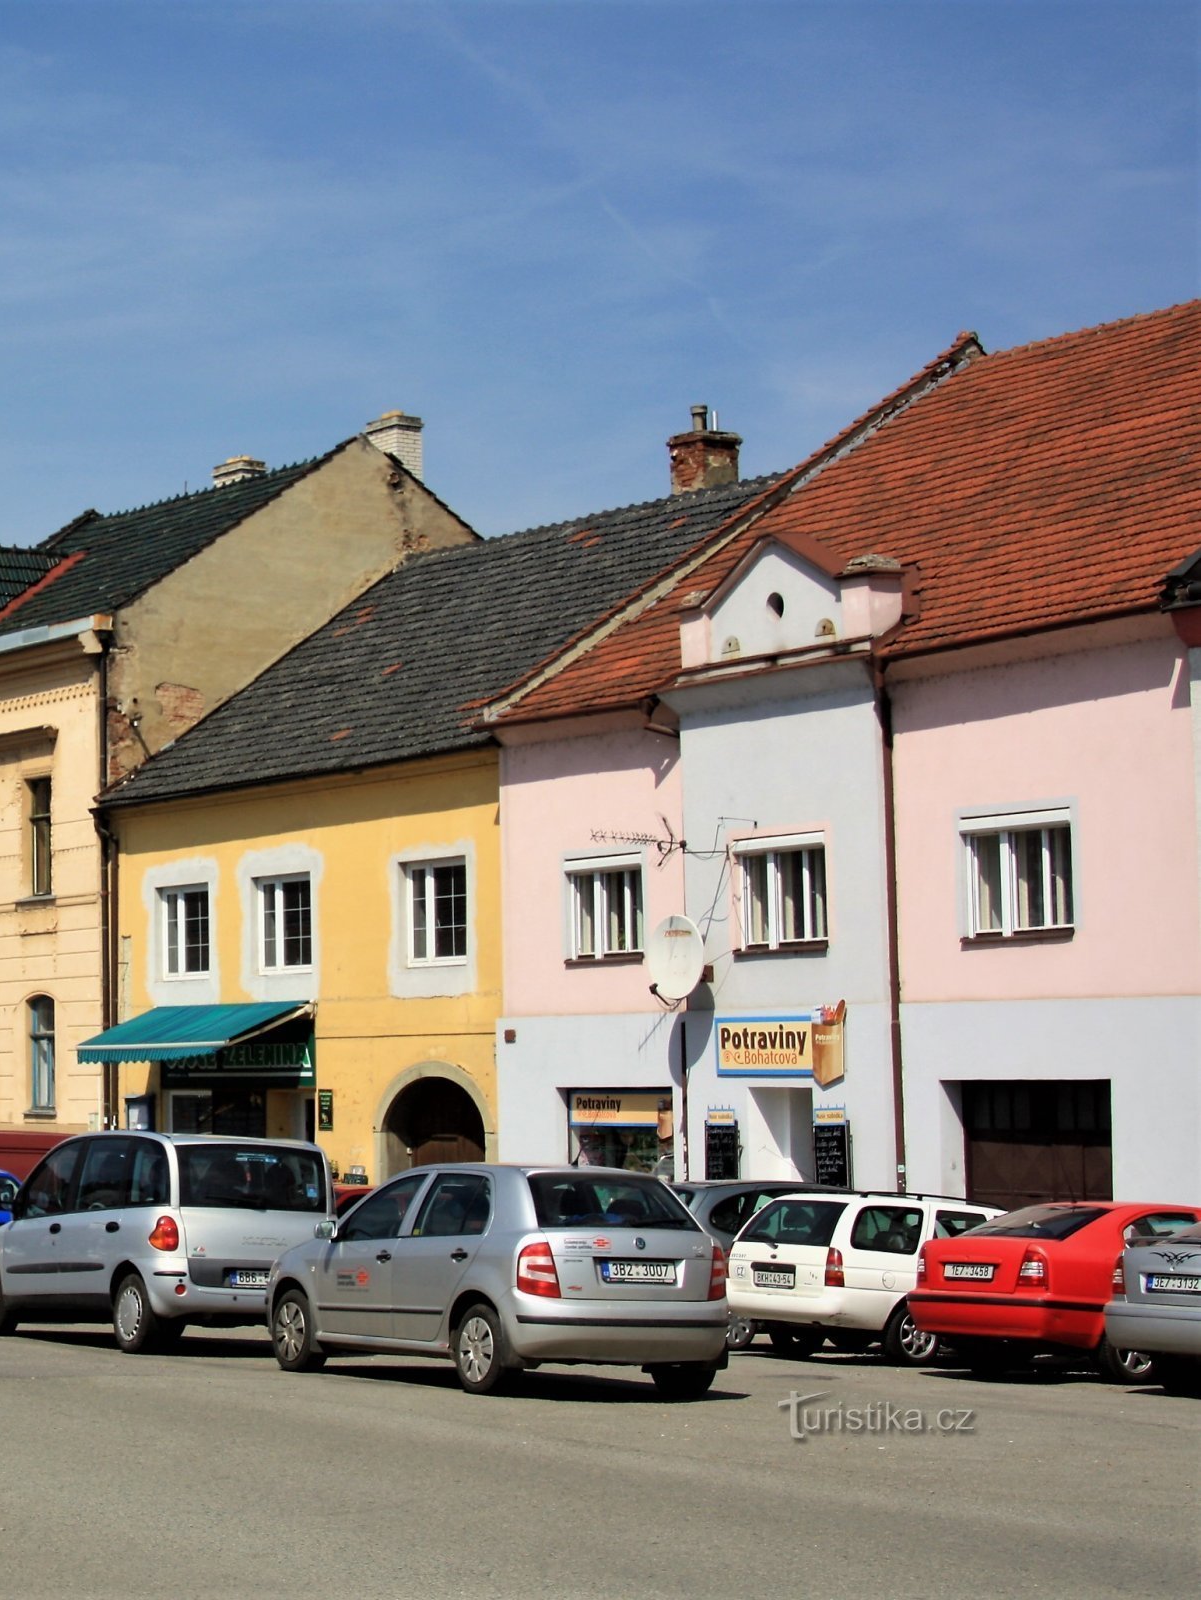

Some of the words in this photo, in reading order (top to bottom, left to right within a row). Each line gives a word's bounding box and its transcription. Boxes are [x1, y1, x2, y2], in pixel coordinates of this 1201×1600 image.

[720, 1024, 807, 1056] Potraviny
[222, 1043, 312, 1068] ZELENINA
[744, 1049, 798, 1065] Bohatcová
[576, 1095, 622, 1113] Potraviny
[239, 1271, 257, 1283] 6B6
[612, 1263, 633, 1277] 3B2
[642, 1264, 669, 1277] 3007
[951, 1265, 965, 1275] 1E7
[969, 1266, 989, 1277] 3458
[757, 1272, 769, 1283] BKH
[772, 1273, 791, 1284] 43-54
[1154, 1276, 1171, 1288] 3E7
[1177, 1277, 1198, 1289] 3132
